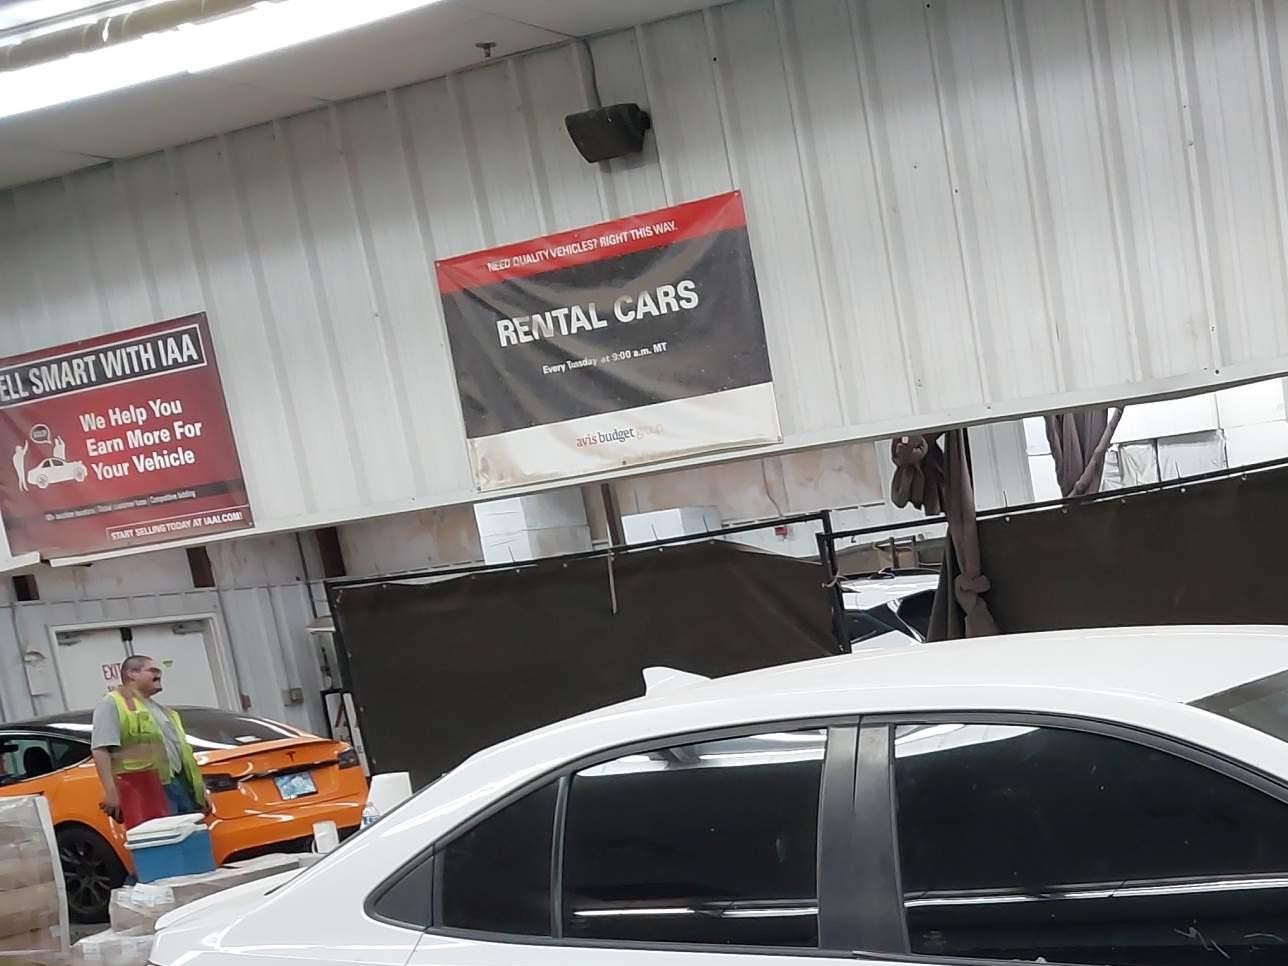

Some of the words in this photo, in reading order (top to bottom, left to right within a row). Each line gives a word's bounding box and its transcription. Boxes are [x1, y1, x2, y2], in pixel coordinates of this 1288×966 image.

[487, 260, 511, 273] NEED
[513, 249, 550, 265] QUALITY
[549, 238, 598, 258] VEHICLES?
[600, 232, 629, 248] RIGHT
[629, 226, 653, 241] THIS
[496, 302, 608, 347] RENTAL
[613, 279, 700, 323] CARS
[29, 355, 97, 395] SMART
[99, 343, 156, 379] WITH
[157, 334, 199, 367] IAA
[542, 363, 566, 374] Every
[566, 357, 598, 370] Tuesday
[600, 355, 610, 363] at
[611, 350, 632, 361] 9:00
[633, 347, 652, 357] a.m.
[653, 342, 668, 353] MT
[79, 413, 106, 432] We
[108, 404, 147, 426] Help
[148, 398, 183, 418] You
[86, 437, 125, 457] Earn
[126, 429, 171, 449] More
[173, 421, 202, 440] For
[576, 433, 598, 448] avis
[597, 428, 635, 443] budget
[91, 462, 130, 481] Your
[131, 446, 195, 473] Vehicle
[111, 529, 135, 541] START
[135, 524, 166, 537] SELLING
[166, 520, 192, 532] TODAY
[192, 518, 202, 528] AT
